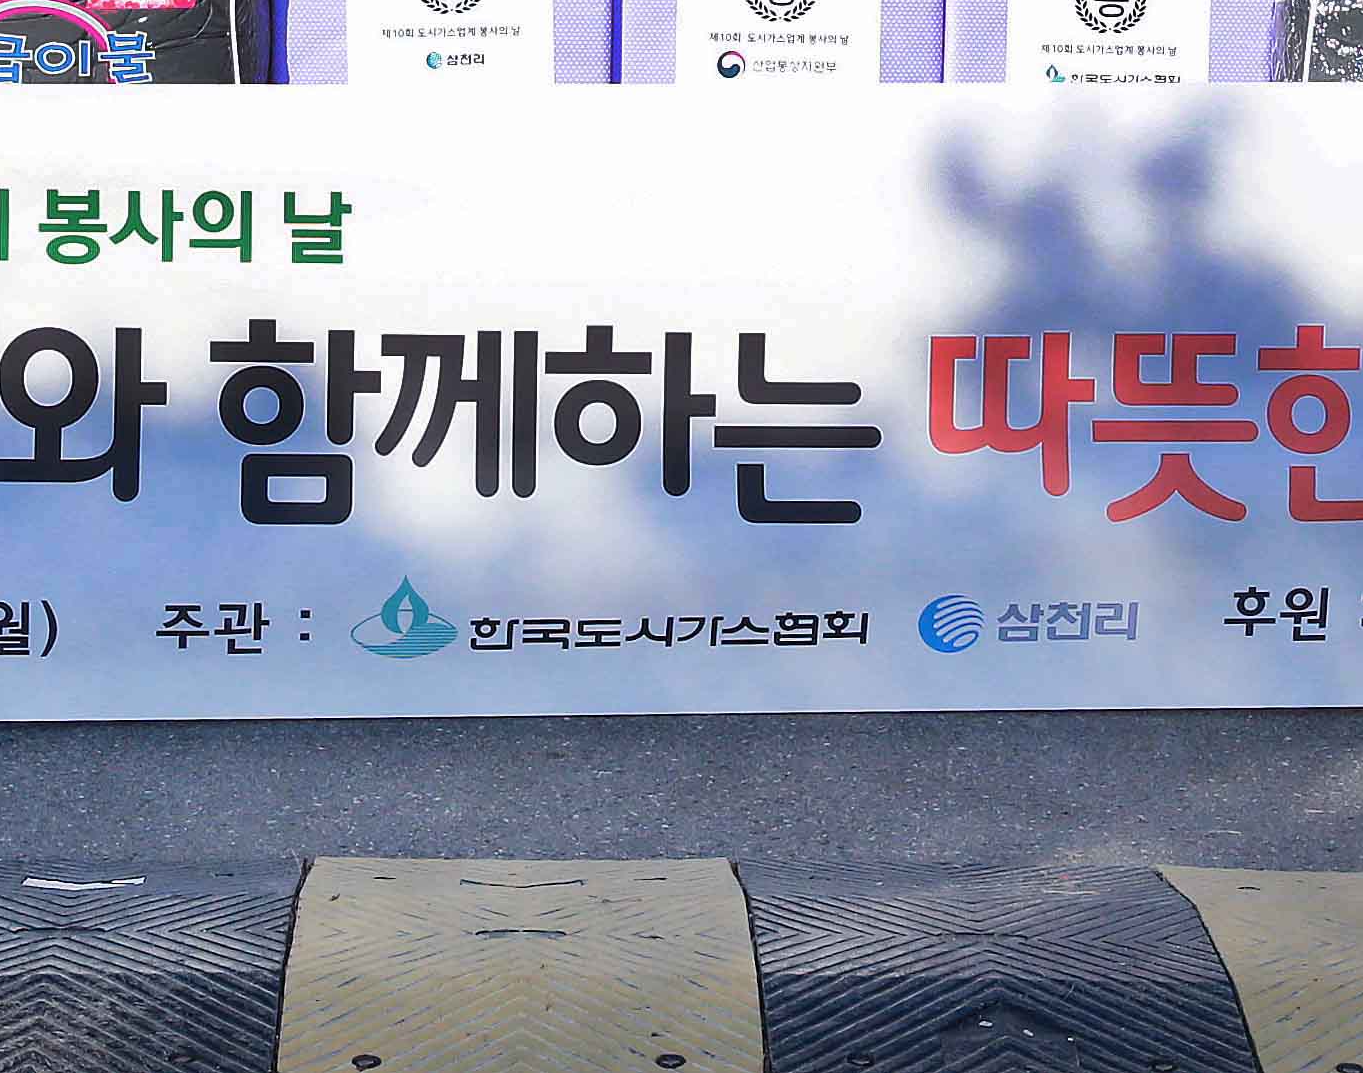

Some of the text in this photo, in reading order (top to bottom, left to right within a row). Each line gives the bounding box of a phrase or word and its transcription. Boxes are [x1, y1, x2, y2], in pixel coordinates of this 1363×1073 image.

[382, 26, 520, 38] 제10회 도시가스업계 봉사의 날
[709, 32, 741, 43] 제10회
[747, 33, 805, 44] 도시가스업계
[809, 34, 837, 45] 봉사의
[446, 53, 485, 66] 삼천리
[1076, 44, 1134, 55] 도시가스업계
[1137, 45, 1165, 56] 봉사의
[38, 188, 254, 263] 봉사의
[282, 190, 352, 265] 날
[209, 318, 883, 526] 함께하는
[468, 610, 871, 651] 한국도시가스협회
[996, 600, 1140, 643] 삼천리
